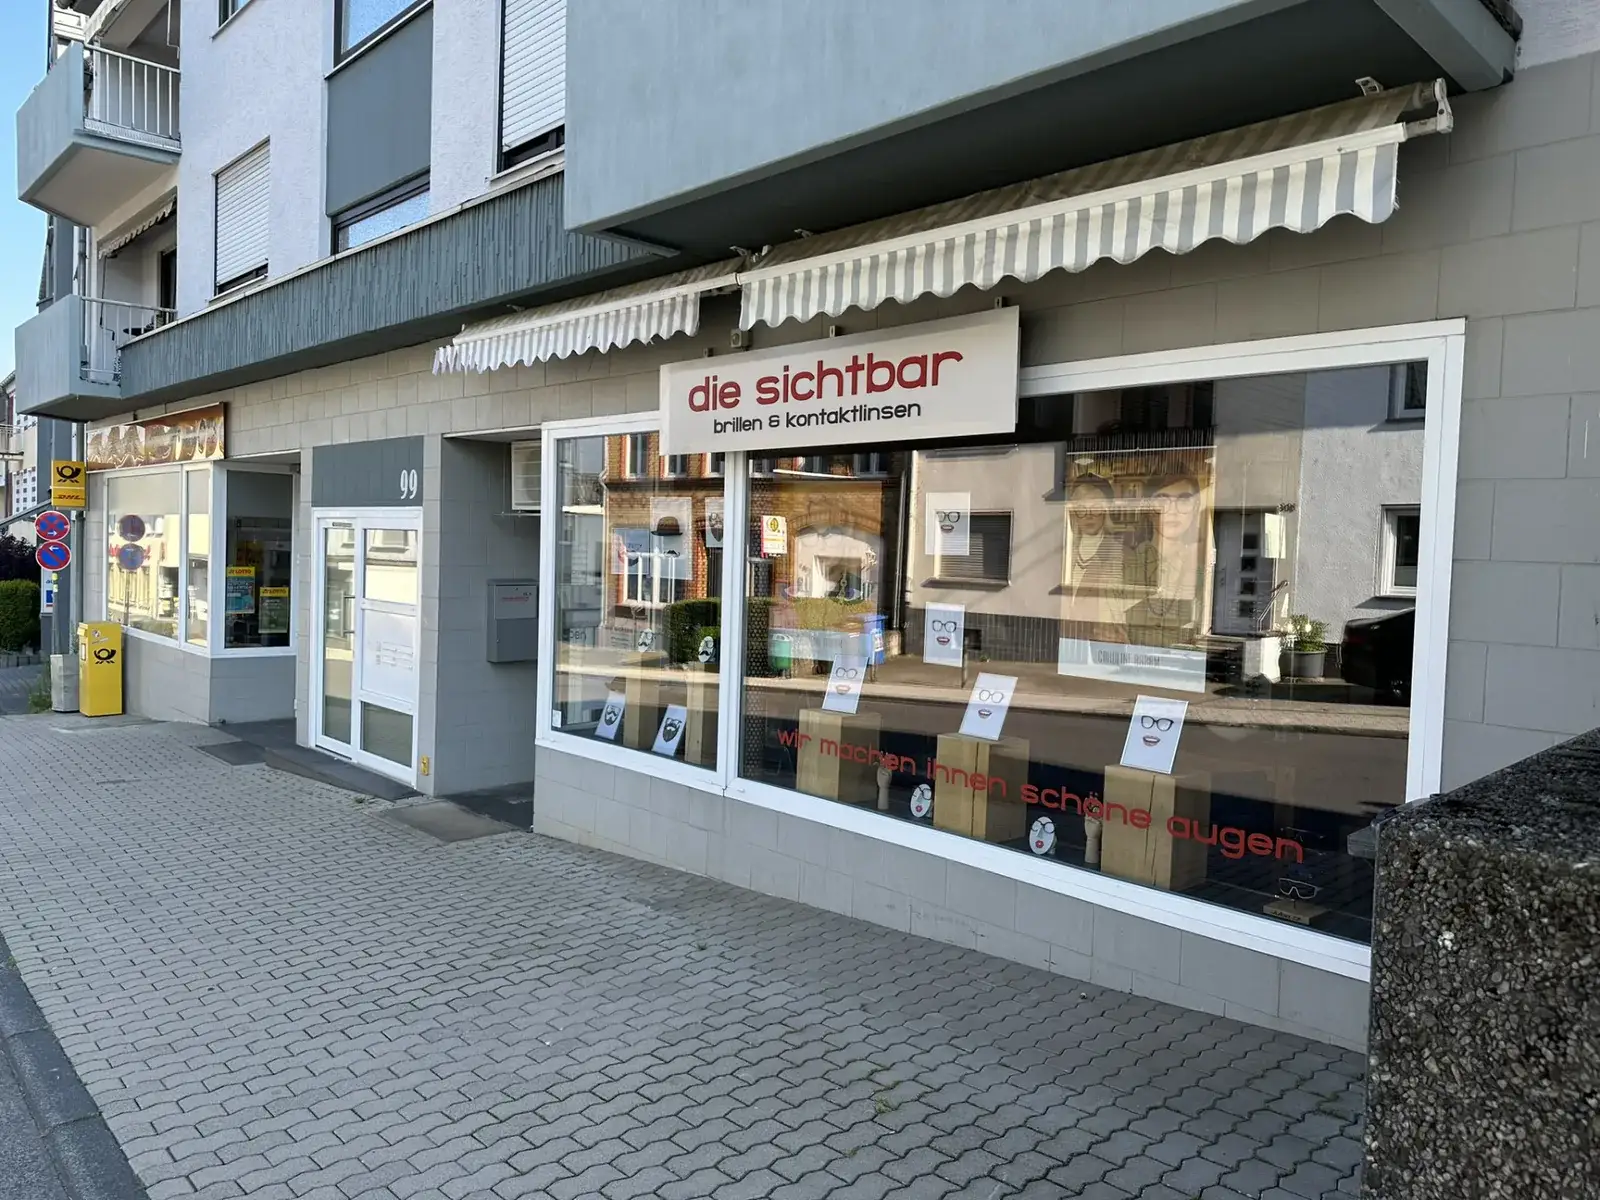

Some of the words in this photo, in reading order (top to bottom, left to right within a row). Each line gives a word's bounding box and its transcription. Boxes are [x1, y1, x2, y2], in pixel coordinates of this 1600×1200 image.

[688, 374, 741, 412] die
[755, 350, 964, 405] sichtbar
[713, 416, 763, 434] brillen
[768, 414, 780, 428] &
[785, 402, 922, 429] kontaktlinsen
[400, 469, 418, 500] 99
[777, 728, 812, 750] wir
[820, 737, 917, 776] machen
[926, 757, 1007, 797] ihnen
[1020, 784, 1151, 829] schöne
[1166, 816, 1304, 864] augen
